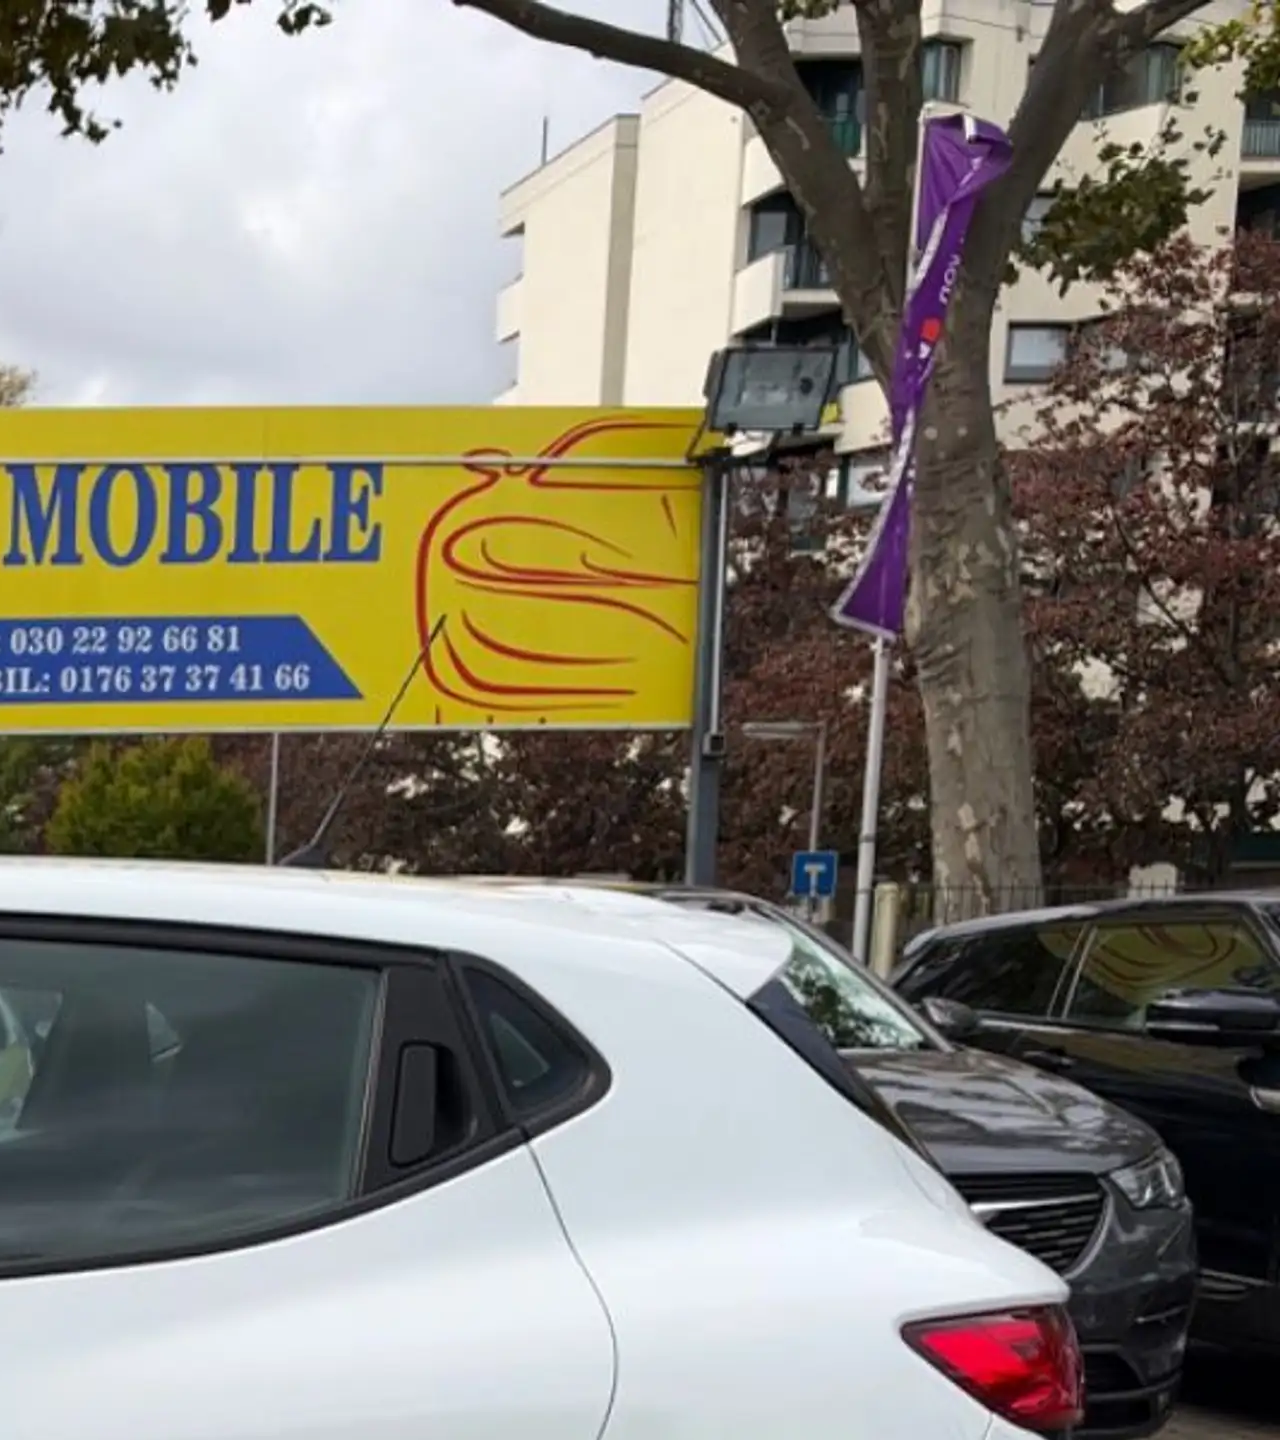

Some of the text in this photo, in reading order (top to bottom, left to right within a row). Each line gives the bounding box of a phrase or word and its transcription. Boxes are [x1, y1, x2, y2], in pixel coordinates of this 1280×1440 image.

[2, 463, 384, 568] MOBILE
[10, 626, 64, 655] 030
[72, 626, 109, 655] 22
[117, 625, 153, 653] 92
[163, 625, 199, 652] 66
[207, 624, 240, 652] 81
[60, 665, 132, 693] 0176
[141, 664, 176, 693] 37
[185, 664, 221, 692] 37
[229, 664, 263, 692] 41
[274, 663, 311, 691] 66
